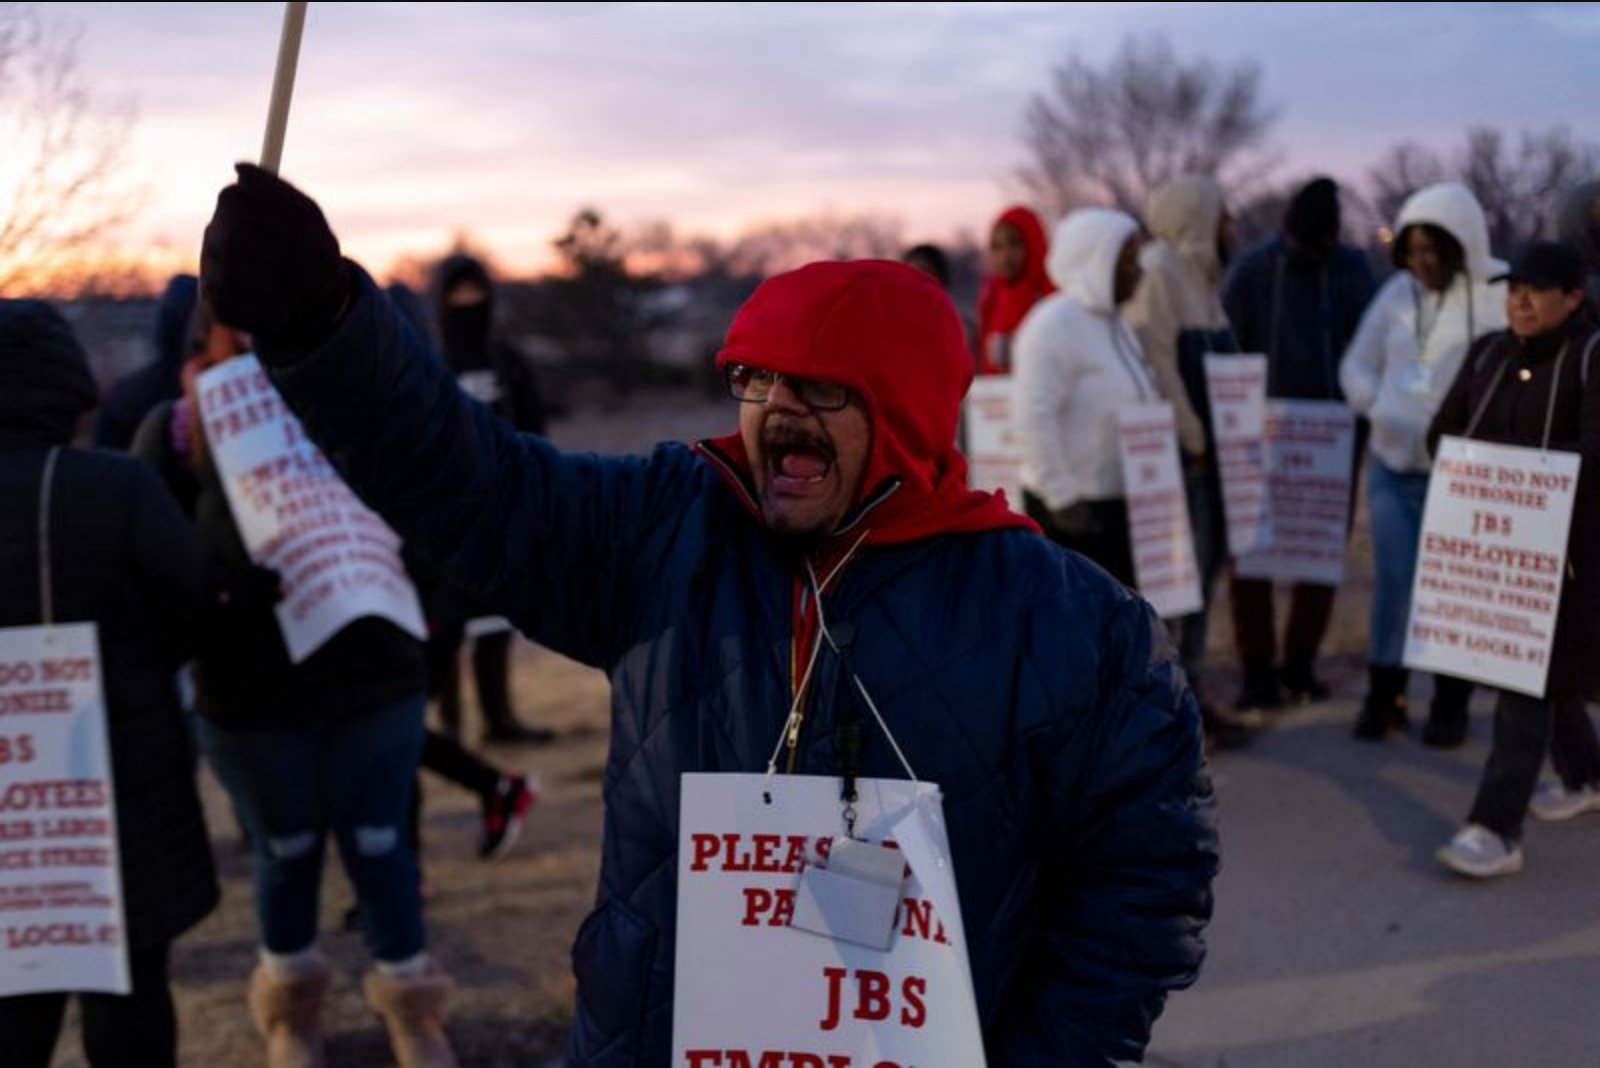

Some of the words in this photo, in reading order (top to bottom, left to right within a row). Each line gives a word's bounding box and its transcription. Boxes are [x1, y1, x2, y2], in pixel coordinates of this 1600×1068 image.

[1498, 465, 1525, 484] DO
[1530, 470, 1572, 492] NOT
[1449, 481, 1547, 510] PATRONIZE
[1473, 510, 1513, 538] JBS
[1425, 532, 1559, 573] EMPLOYEES
[41, 657, 92, 683] NOT
[690, 833, 834, 875] PLEAS
[819, 966, 927, 1031] JBS
